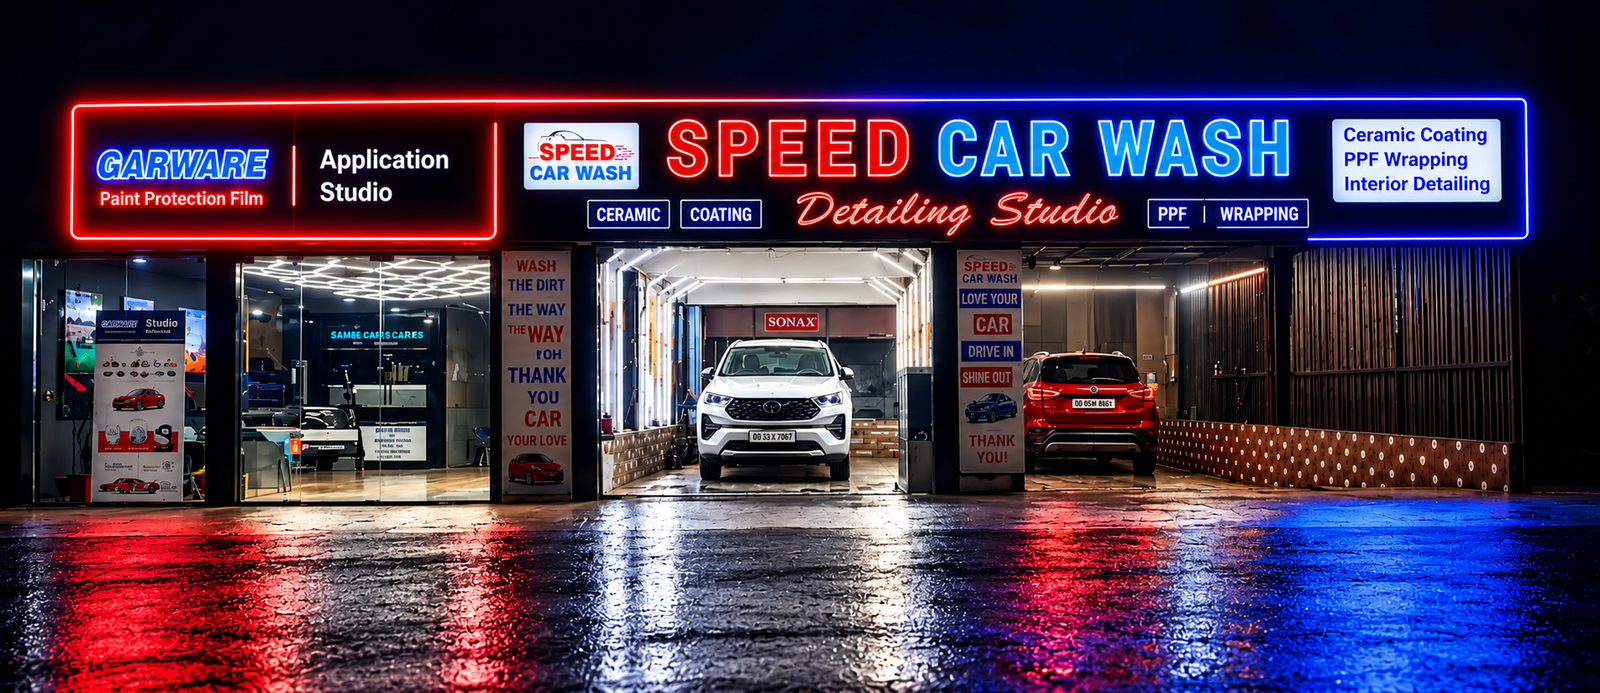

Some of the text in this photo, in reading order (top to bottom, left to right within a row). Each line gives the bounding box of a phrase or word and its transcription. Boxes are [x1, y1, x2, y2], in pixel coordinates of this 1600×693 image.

[1343, 127, 1488, 145] Ceramic Coating
[539, 142, 616, 161] SPEED
[667, 119, 1290, 178] SPEED CAR WASH
[96, 149, 269, 180] GARWARE
[319, 148, 449, 174] Application
[1344, 152, 1468, 170] PPF Wrapping
[529, 165, 632, 181] CAR WASH
[319, 181, 393, 202] Studio
[1344, 176, 1490, 194] Interior Detailing
[100, 191, 264, 206] Paint Protection Film
[596, 207, 661, 222] CERAMIC
[690, 207, 752, 222] COATING
[796, 191, 1119, 236] Detailing Studio
[1158, 206, 1299, 221] PPF WRAPPING
[516, 259, 556, 272] WASH
[964, 261, 1008, 272] SPEED
[507, 279, 566, 291] THE DIRT
[962, 274, 1017, 283] CAR WASH
[961, 293, 1018, 305] LOVE YOUR
[507, 303, 566, 316] THE WAY
[146, 318, 178, 328] Studio
[768, 316, 816, 327] SONAX
[976, 316, 1009, 332] CAR
[507, 324, 564, 343] THE WAY
[968, 345, 1014, 358] DRIVE IN
[507, 367, 566, 383] THANK
[962, 371, 1011, 384] SHINE OUT
[527, 391, 559, 404] YOU
[525, 410, 562, 427] CAR
[507, 435, 567, 446] YOUR LOVE
[968, 434, 1016, 447] THANK
[976, 451, 1008, 464] YOU!
